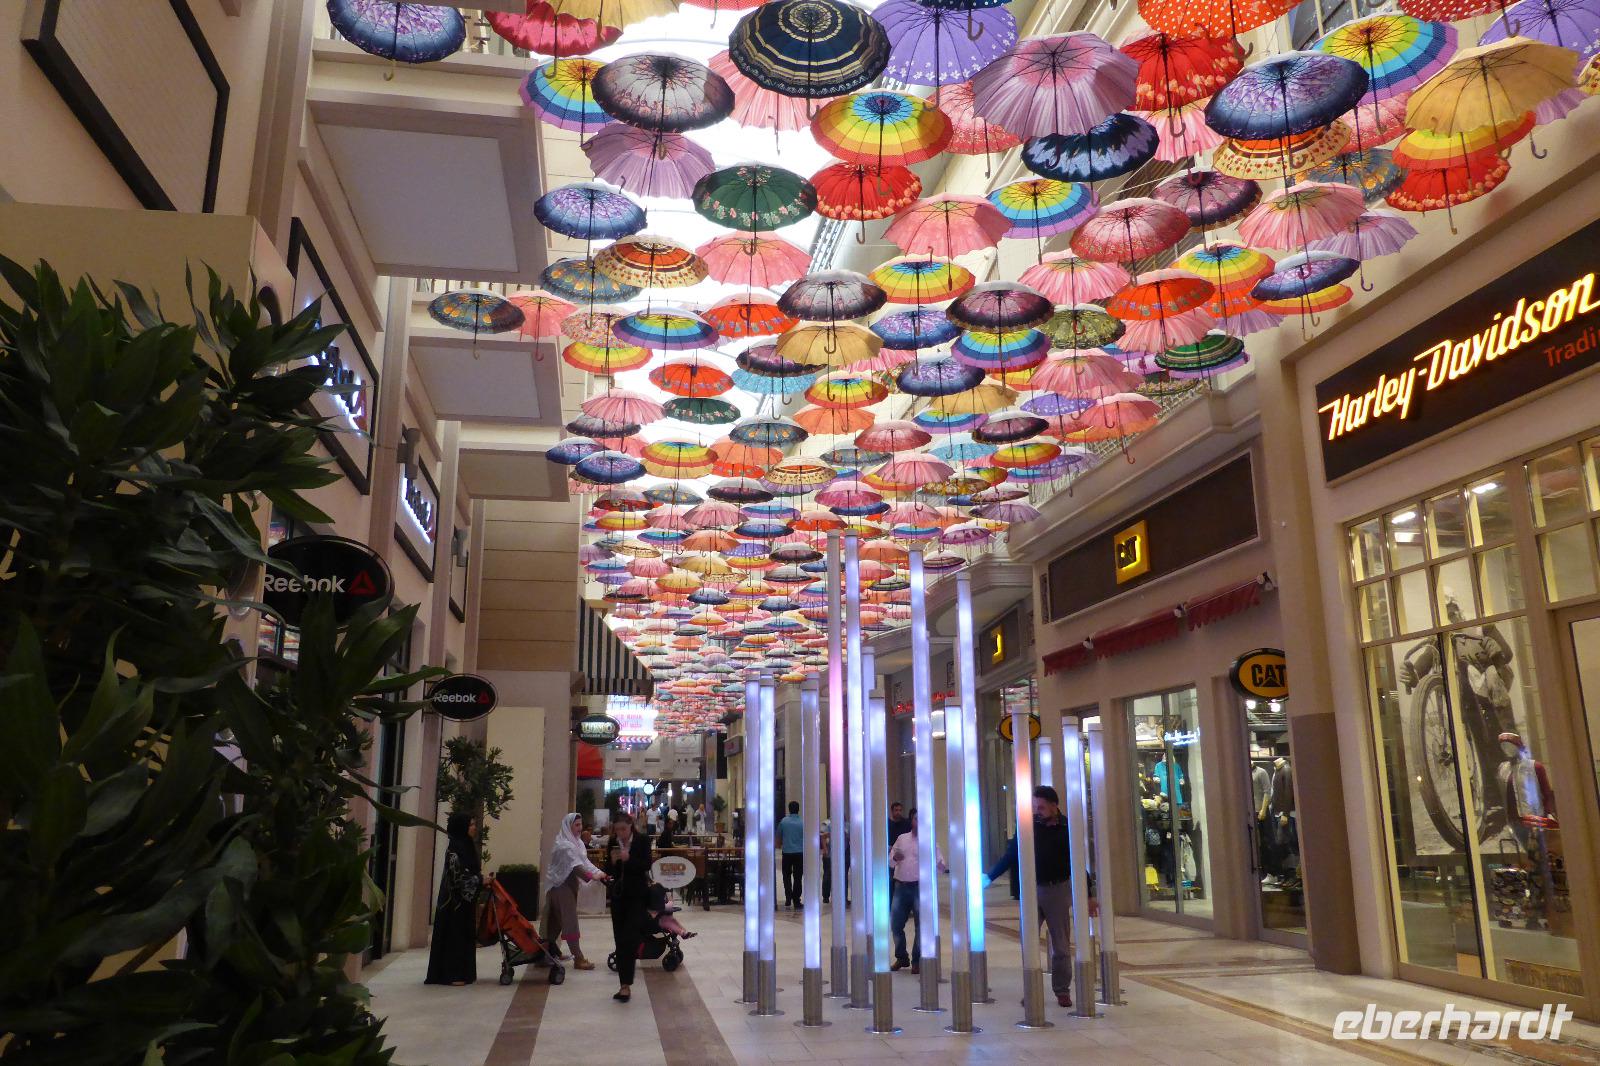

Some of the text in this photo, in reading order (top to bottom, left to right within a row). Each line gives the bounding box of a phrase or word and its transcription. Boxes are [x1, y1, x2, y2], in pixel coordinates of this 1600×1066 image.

[1319, 272, 1600, 441] Harley-Davidson
[1544, 326, 1600, 367] Tradi
[263, 574, 346, 593] Reebok
[1251, 663, 1287, 688] CAT
[434, 693, 477, 703] Reebok
